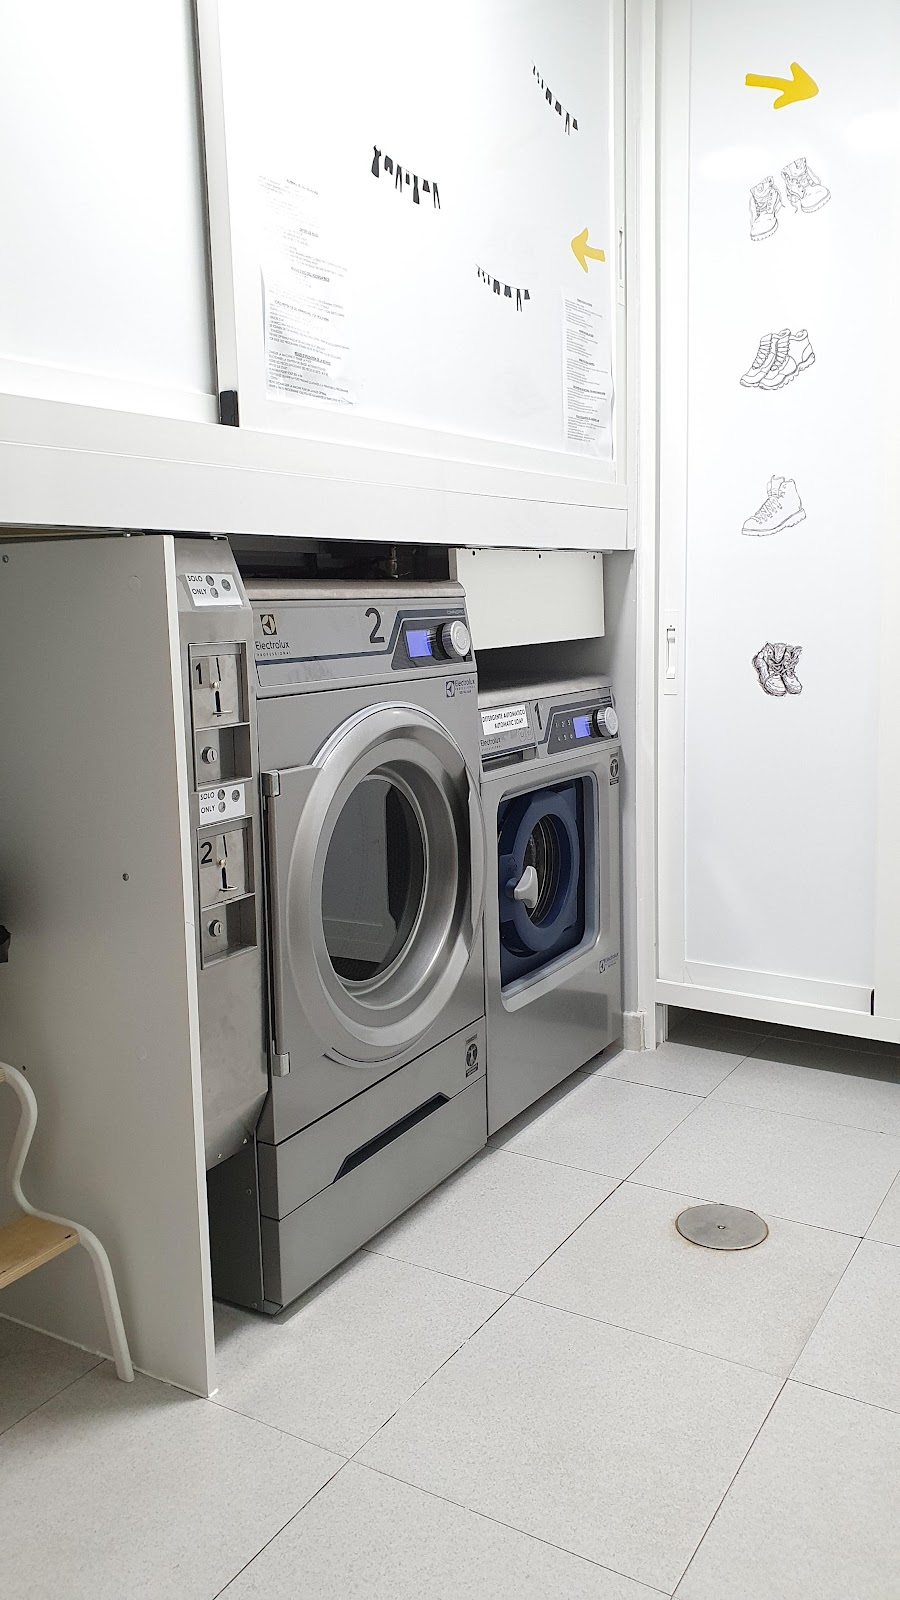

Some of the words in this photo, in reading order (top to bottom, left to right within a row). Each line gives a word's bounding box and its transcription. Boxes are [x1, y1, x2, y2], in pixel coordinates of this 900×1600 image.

[364, 607, 386, 644] 2
[255, 640, 290, 651] Electrolux
[195, 662, 204, 685] 1
[455, 679, 475, 687] Electrolux
[534, 702, 543, 730] 1
[480, 736, 501, 747] Electrolux
[200, 790, 215, 801] SOLO
[200, 804, 215, 814] ONLY
[200, 842, 213, 865] 2
